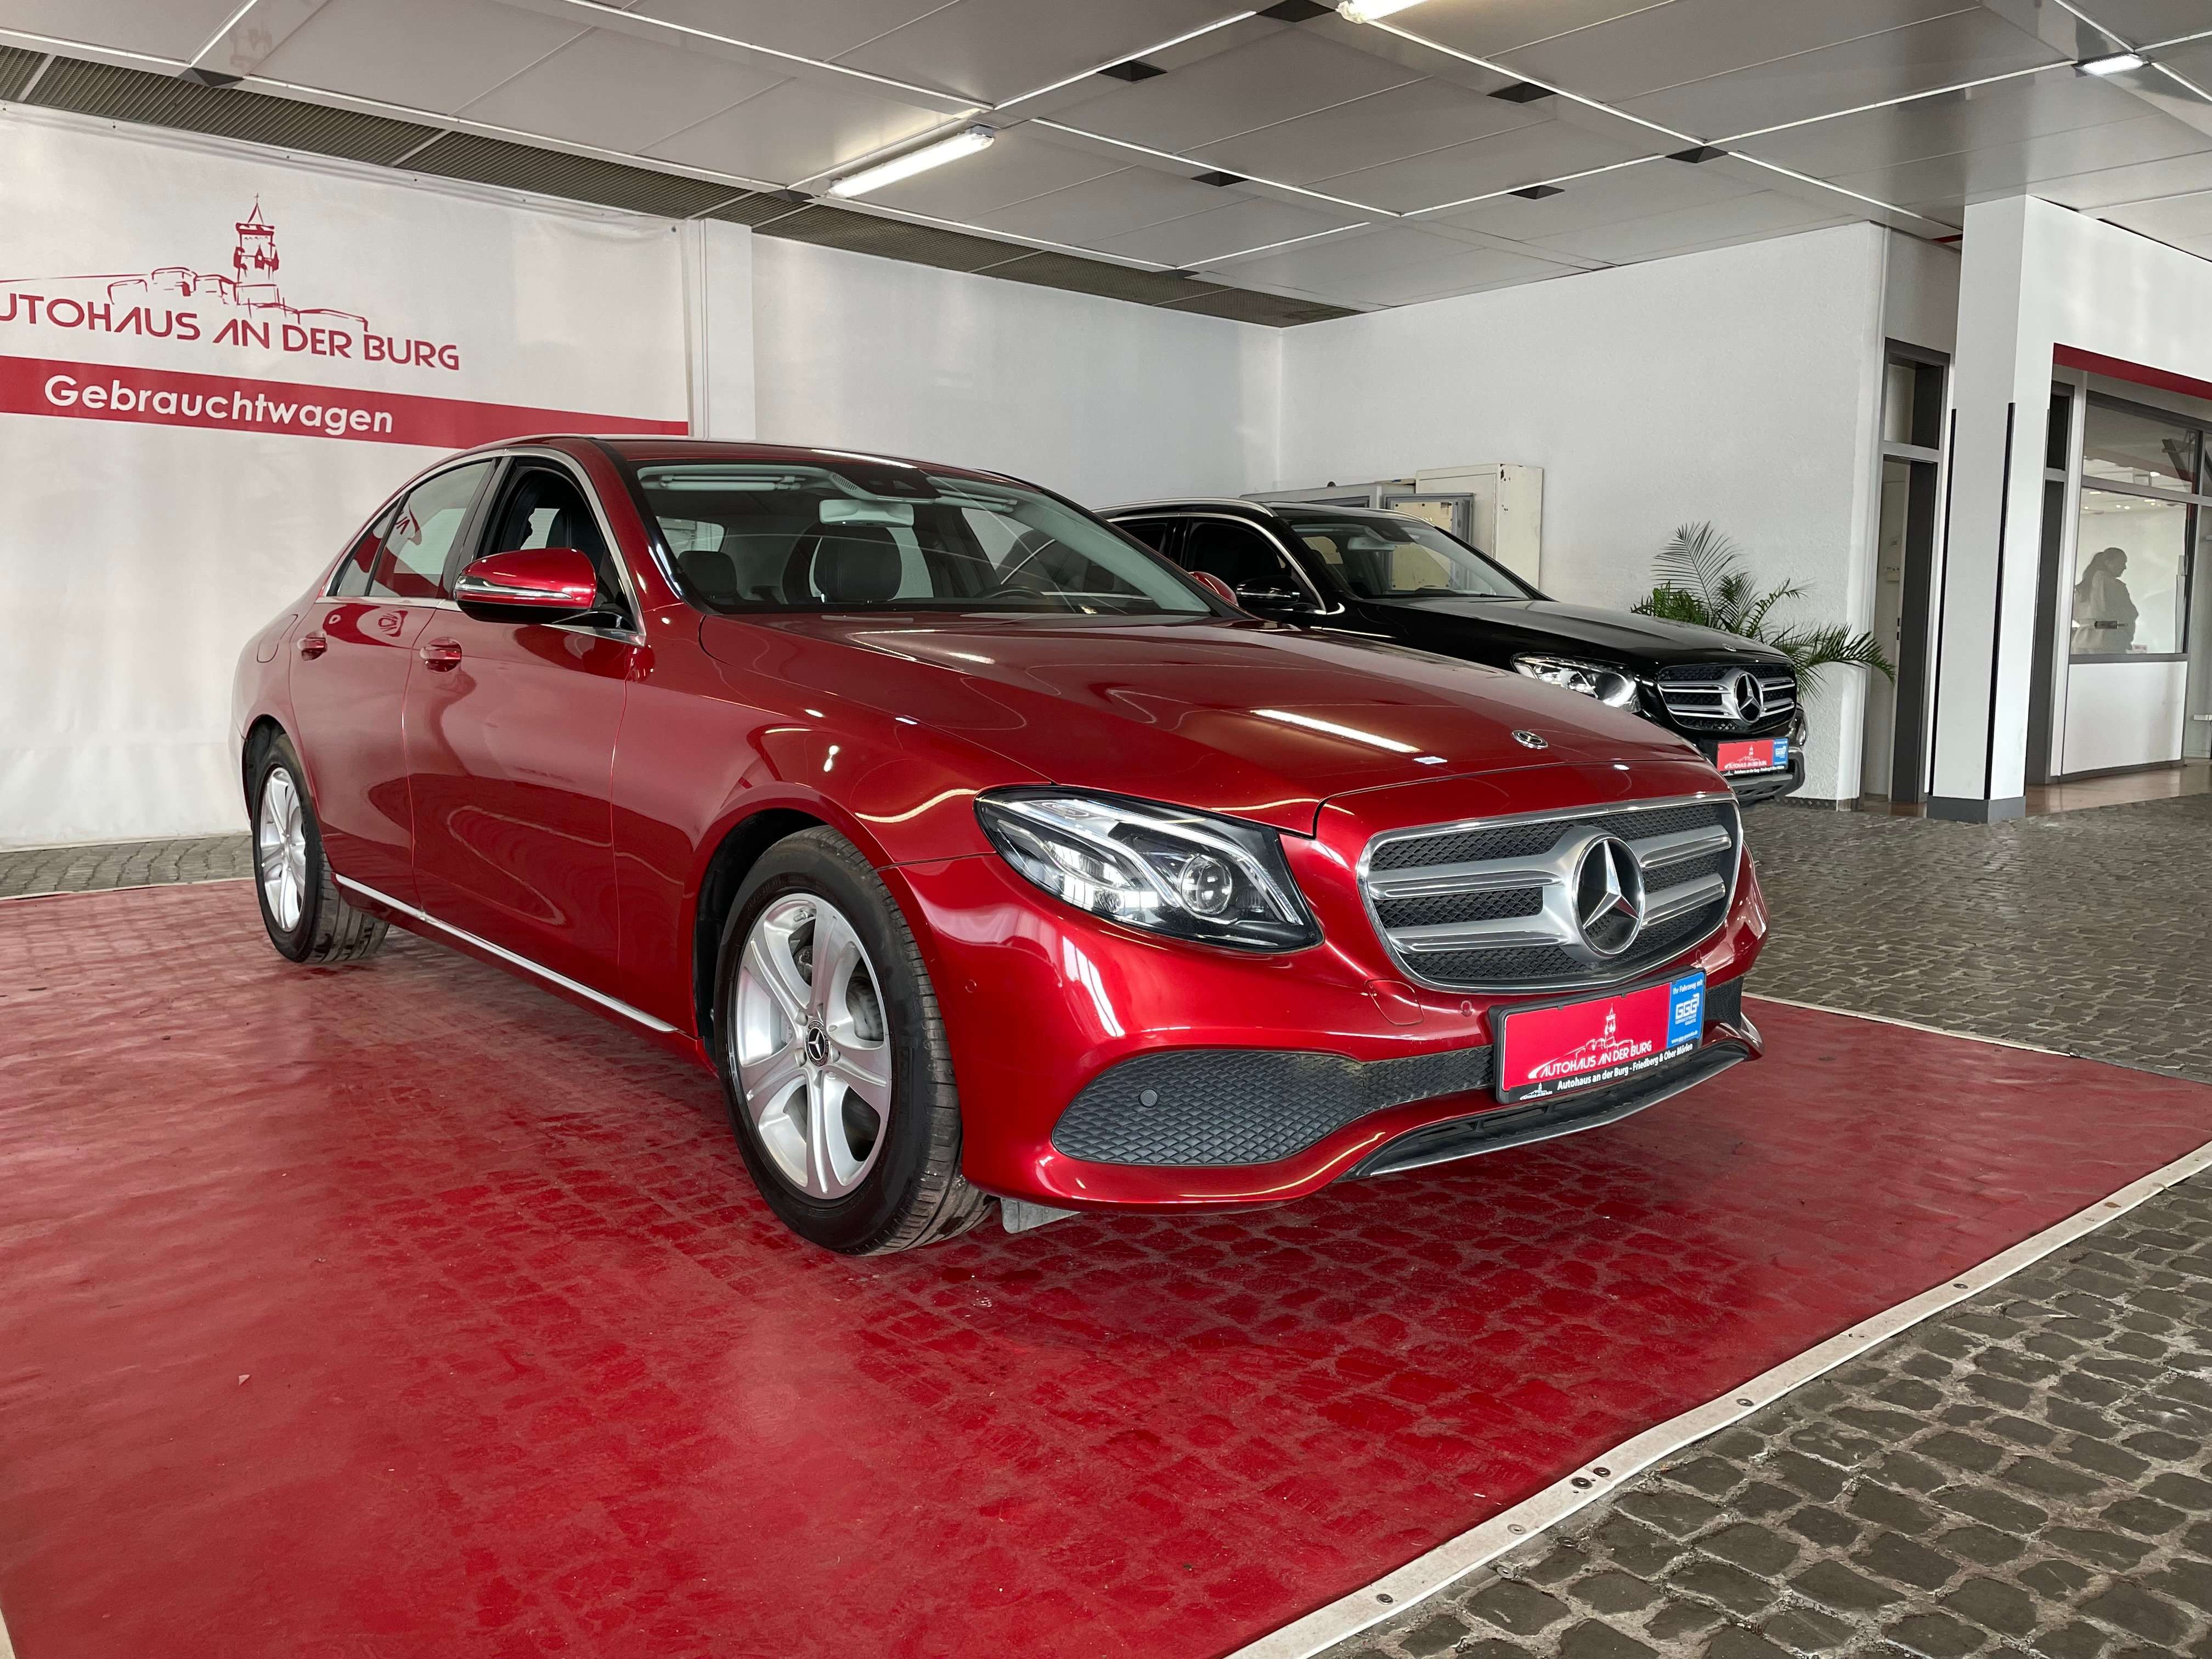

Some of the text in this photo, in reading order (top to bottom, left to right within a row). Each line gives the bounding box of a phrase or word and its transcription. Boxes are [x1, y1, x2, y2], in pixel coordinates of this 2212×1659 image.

[212, 318, 270, 349] AN
[282, 324, 352, 359] DER
[363, 334, 459, 371] BURG
[44, 374, 393, 436] Gebrauchtwagen
[1675, 997, 1699, 1020] GGG
[1679, 982, 1696, 993] Fahrzeug
[1540, 1040, 1652, 1079] AUTOHAUS AN DER BURG
[1556, 1074, 1592, 1091] Autohaus
[1592, 1073, 1601, 1083] an
[1601, 1069, 1613, 1080] der
[1614, 1066, 1629, 1077] Burg
[1633, 1056, 1659, 1071] Friedberg
[1659, 1053, 1664, 1063] &
[1664, 1048, 1677, 1060] Ober
[1677, 1042, 1693, 1056] Mörlen
